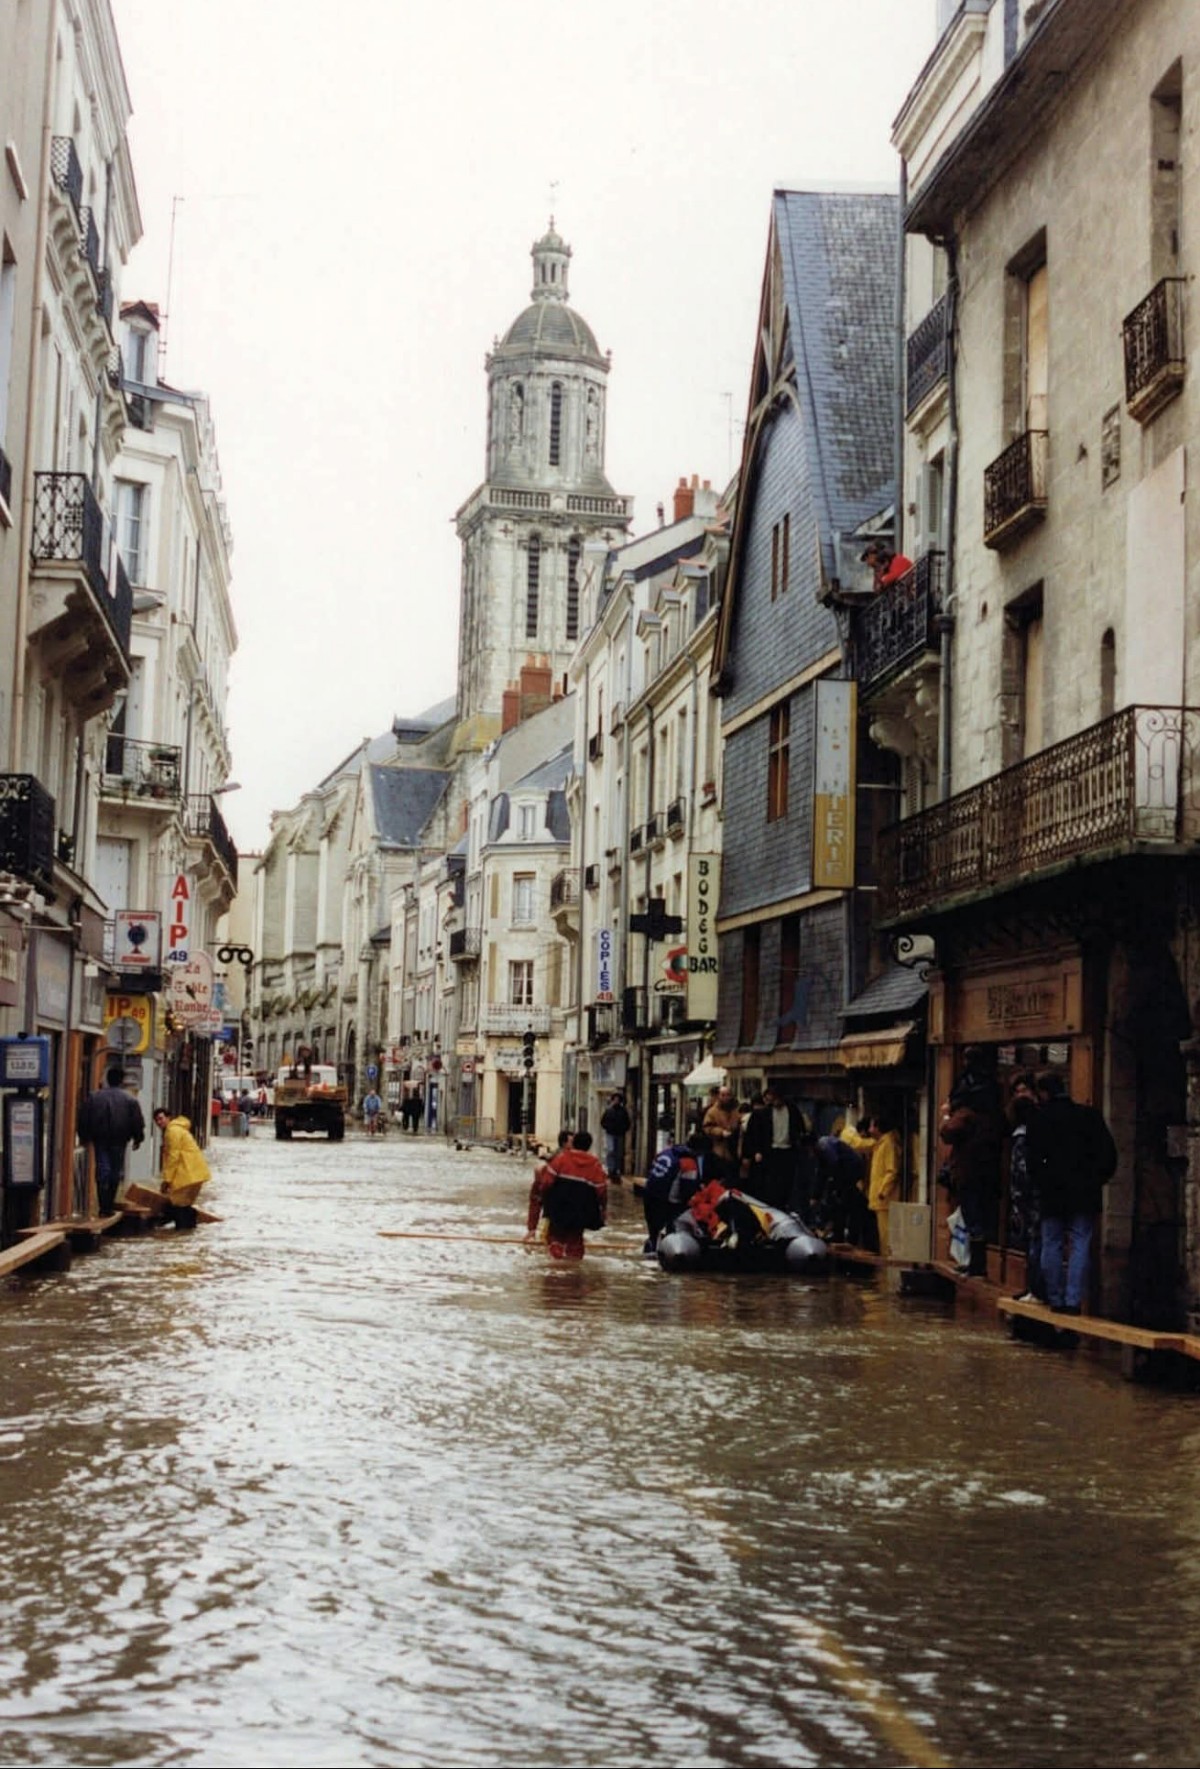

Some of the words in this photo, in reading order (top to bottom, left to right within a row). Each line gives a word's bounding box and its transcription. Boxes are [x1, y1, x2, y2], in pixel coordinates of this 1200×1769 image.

[169, 875, 189, 948] AIP
[169, 950, 188, 962] 49
[600, 930, 610, 992] COPIES
[689, 956, 718, 974] BAR
[597, 992, 613, 1001] 49
